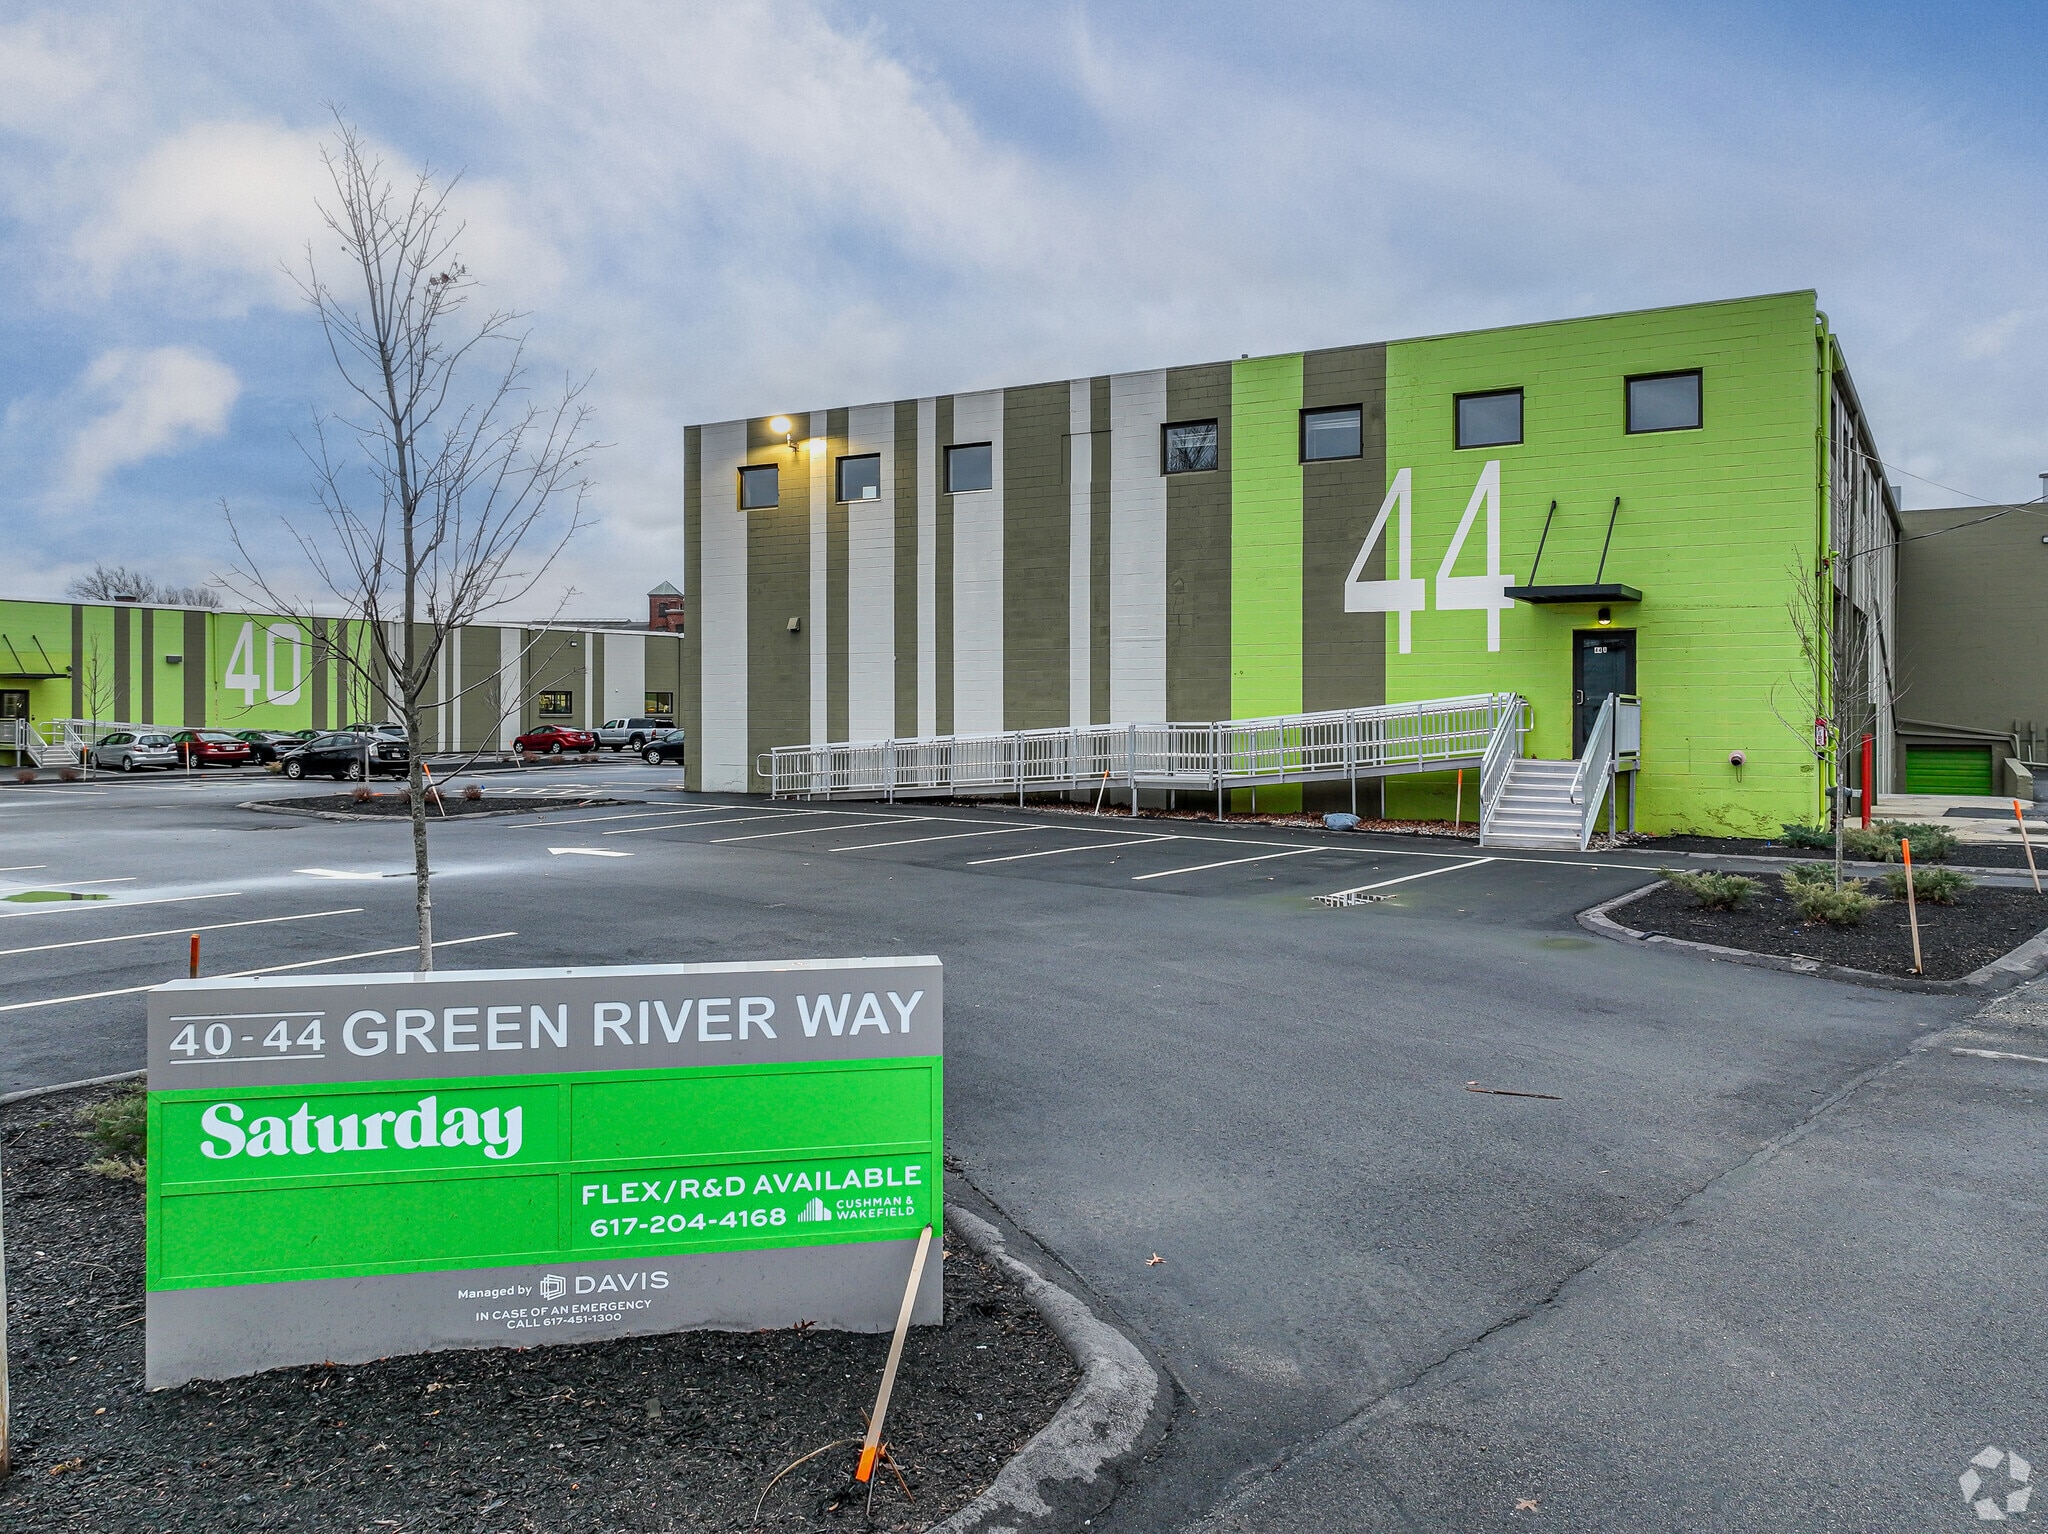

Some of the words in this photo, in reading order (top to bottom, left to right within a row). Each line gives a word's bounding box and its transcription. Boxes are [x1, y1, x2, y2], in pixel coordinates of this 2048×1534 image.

[1344, 459, 1516, 654] 44
[225, 621, 302, 706] 40
[342, 1001, 569, 1057] GREEN
[593, 995, 778, 1047] RIVER
[796, 990, 924, 1038] WAY
[200, 1095, 524, 1160] Saturday
[582, 1176, 746, 1205] FLEX/R&D
[753, 1165, 922, 1195] AVAILABLE
[836, 1196, 902, 1209] CUSHMAN
[905, 1196, 914, 1205] &
[836, 1206, 915, 1220] WAKEFIELD
[590, 1207, 787, 1237] 617-204-4168
[457, 1287, 515, 1300] Managed
[517, 1284, 533, 1297] by
[575, 1270, 670, 1295] DAVIS
[475, 1311, 489, 1322] IN
[492, 1307, 528, 1320] CASE
[530, 1306, 549, 1317] OF
[550, 1305, 569, 1316] AN
[571, 1299, 653, 1314] EMERGENCY
[506, 1318, 541, 1330] CALL
[542, 1312, 622, 1327] 617-451-1300
